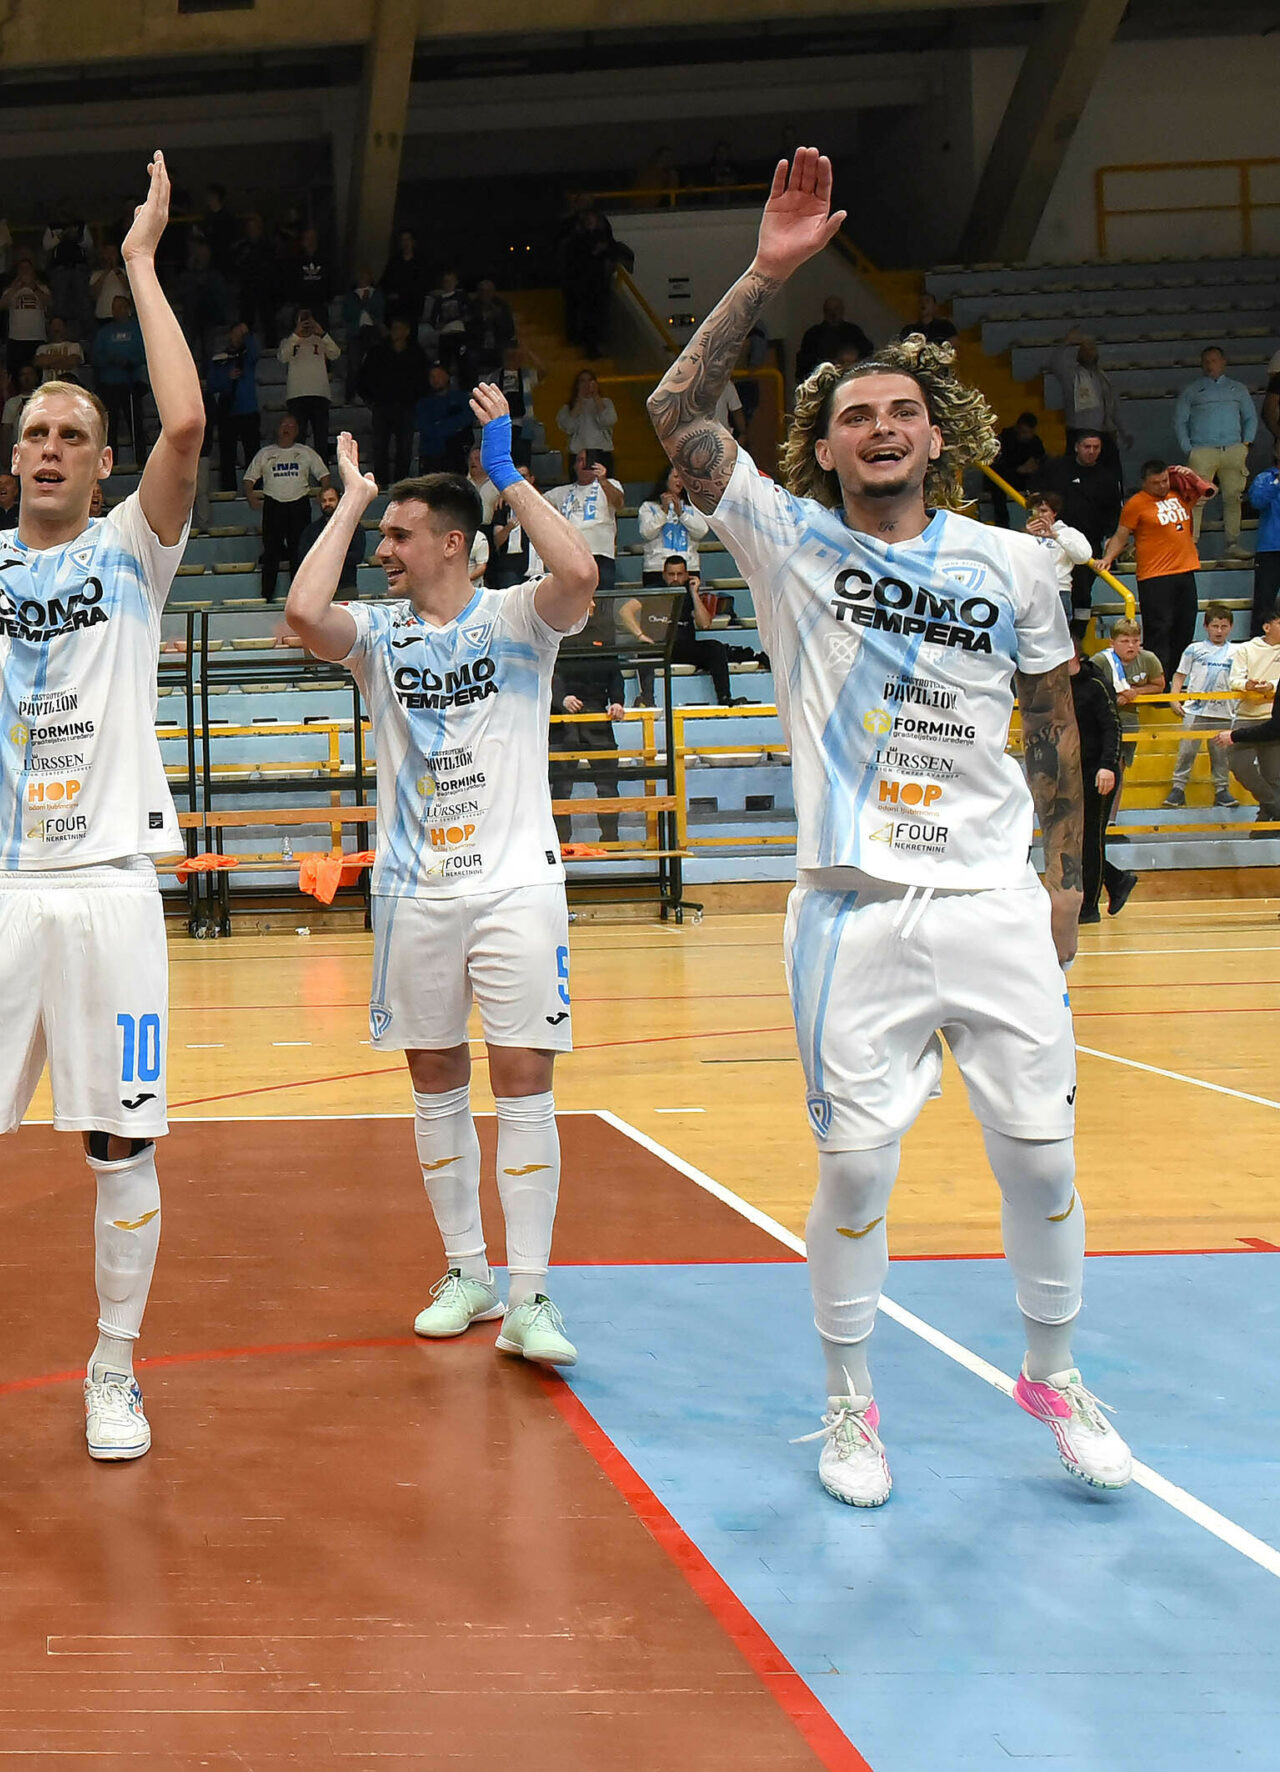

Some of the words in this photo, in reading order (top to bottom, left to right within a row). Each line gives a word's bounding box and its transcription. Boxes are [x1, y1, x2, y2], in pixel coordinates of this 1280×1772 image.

[834, 568, 999, 629] COMO
[831, 600, 993, 654] TEMPERA
[394, 657, 496, 693] COMO
[396, 681, 499, 709] TEMPERA
[30, 721, 94, 740] FORMING
[894, 717, 975, 739] FORMING
[28, 780, 80, 802] HOP
[436, 772, 485, 791] FORMING
[879, 780, 943, 807] HOP
[46, 815, 87, 833] FOUR
[431, 824, 475, 846] HOP
[896, 823, 948, 843] FOUR
[46, 833, 87, 842] NEKRETNINE
[894, 842, 947, 854] NEKRETNINE
[445, 854, 482, 869] FOUR
[117, 1013, 160, 1082] 10
